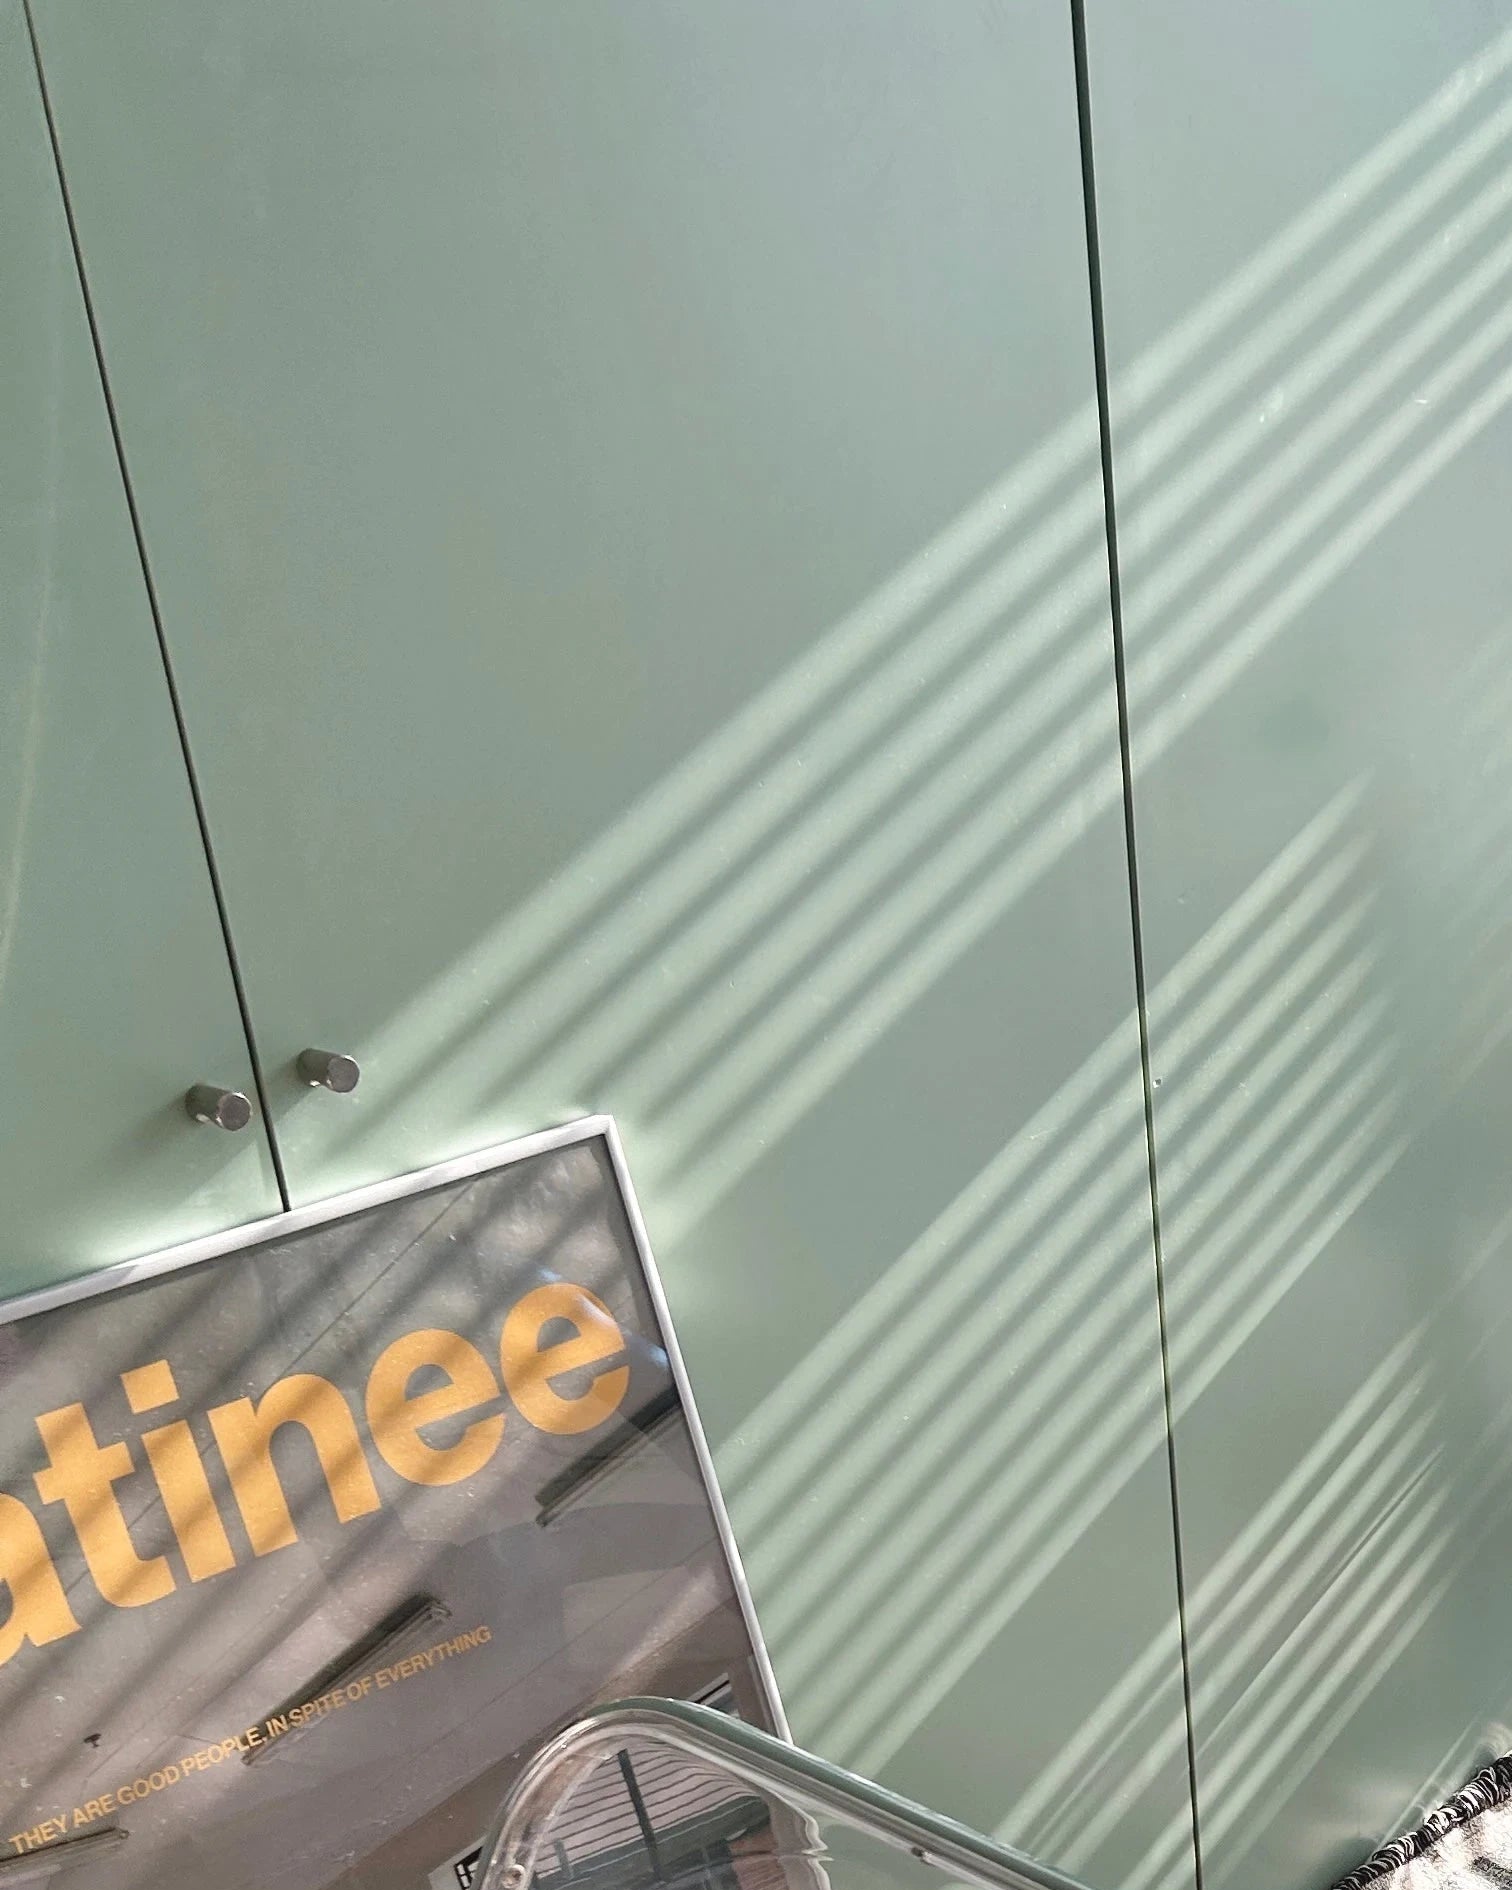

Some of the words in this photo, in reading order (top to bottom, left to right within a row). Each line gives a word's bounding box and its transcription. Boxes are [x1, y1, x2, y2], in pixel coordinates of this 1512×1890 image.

[8, 1812, 68, 1854] THEY
[73, 1793, 118, 1829] ARE
[117, 1765, 181, 1806] GOOD
[264, 1713, 290, 1739] IN
[288, 1688, 348, 1728] SPITE
[346, 1675, 374, 1702] OF
[373, 1624, 494, 1690] EVERYTHING
